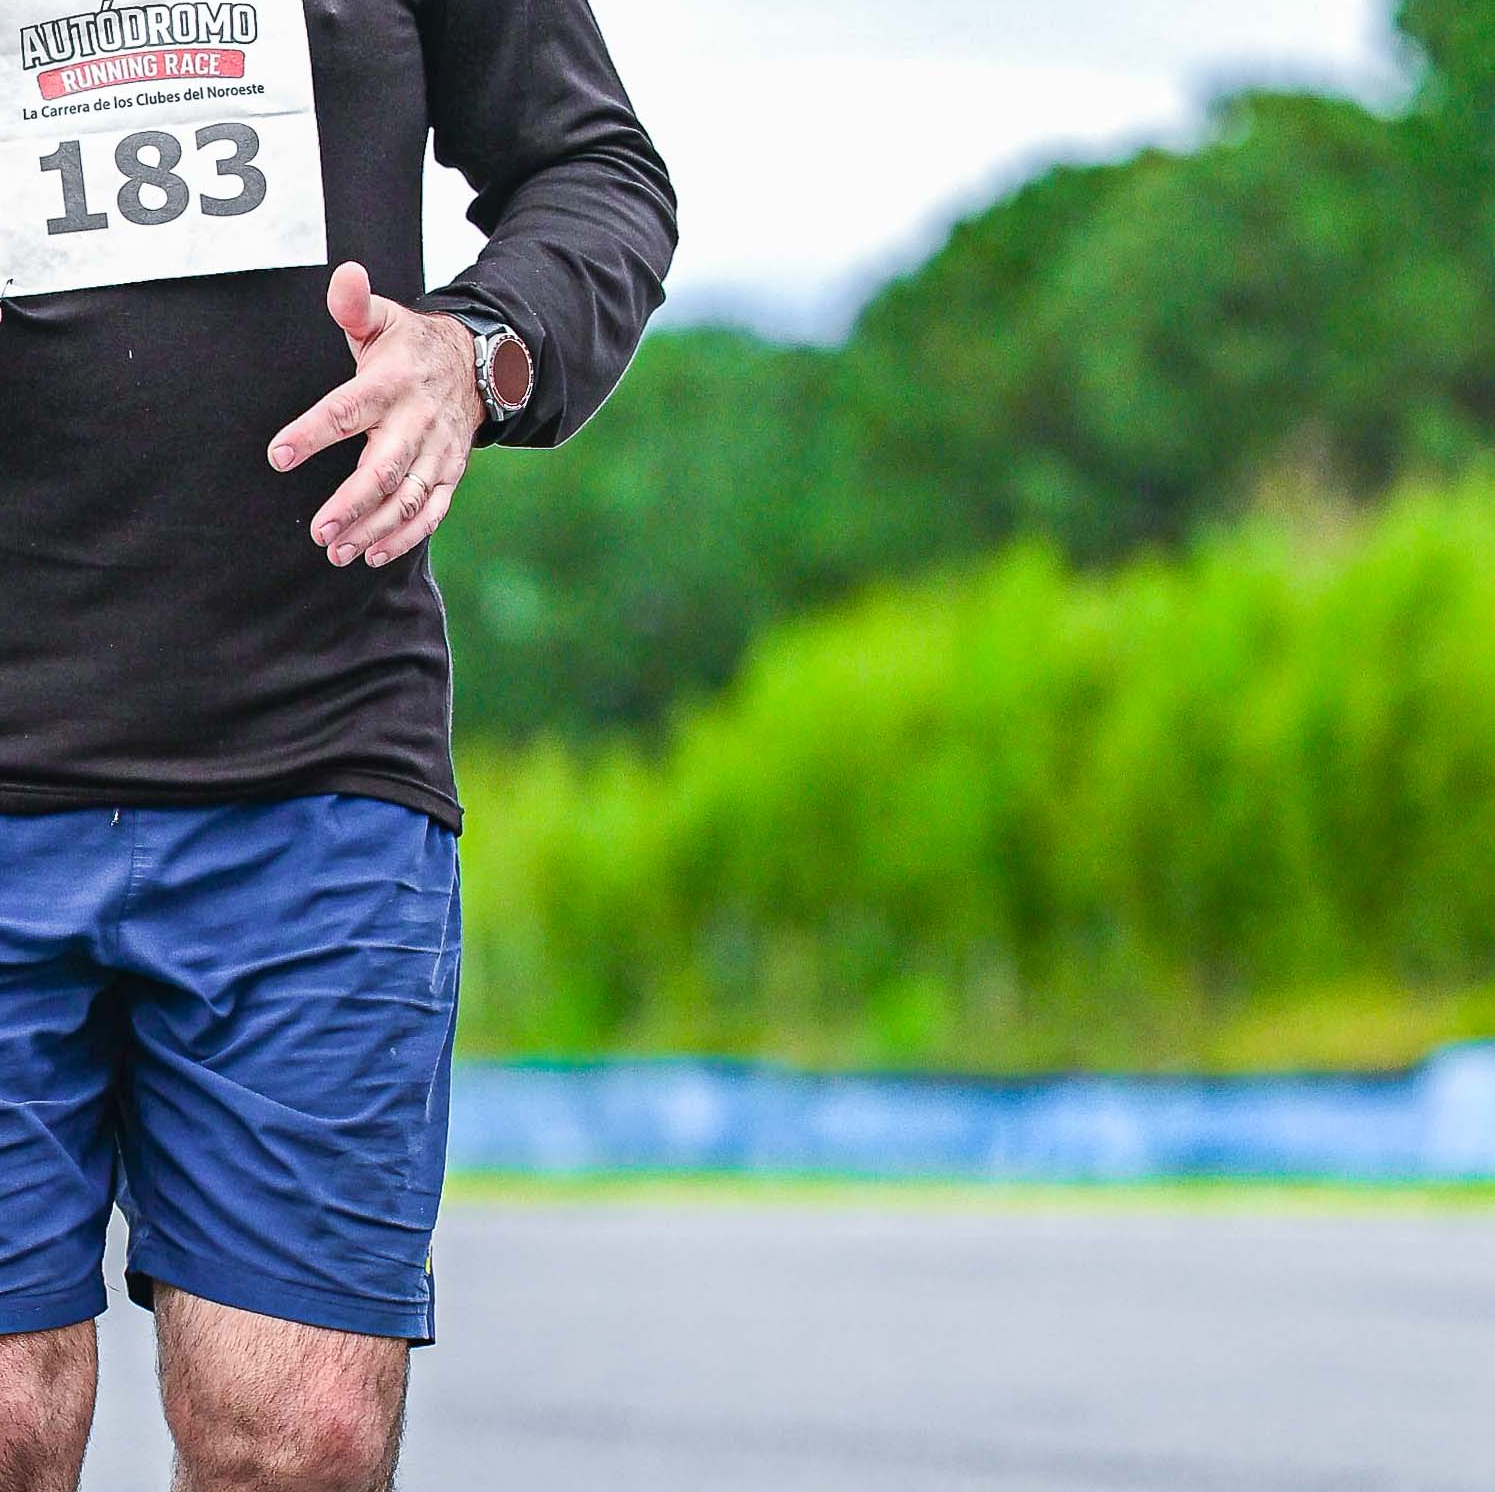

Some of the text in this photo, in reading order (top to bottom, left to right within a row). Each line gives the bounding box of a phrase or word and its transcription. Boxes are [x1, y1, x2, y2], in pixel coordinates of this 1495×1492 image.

[60, 52, 222, 92] RUNNING RACE
[23, 84, 265, 120] La Carrera de los Clubes del Noroeste
[39, 122, 267, 235] 183
